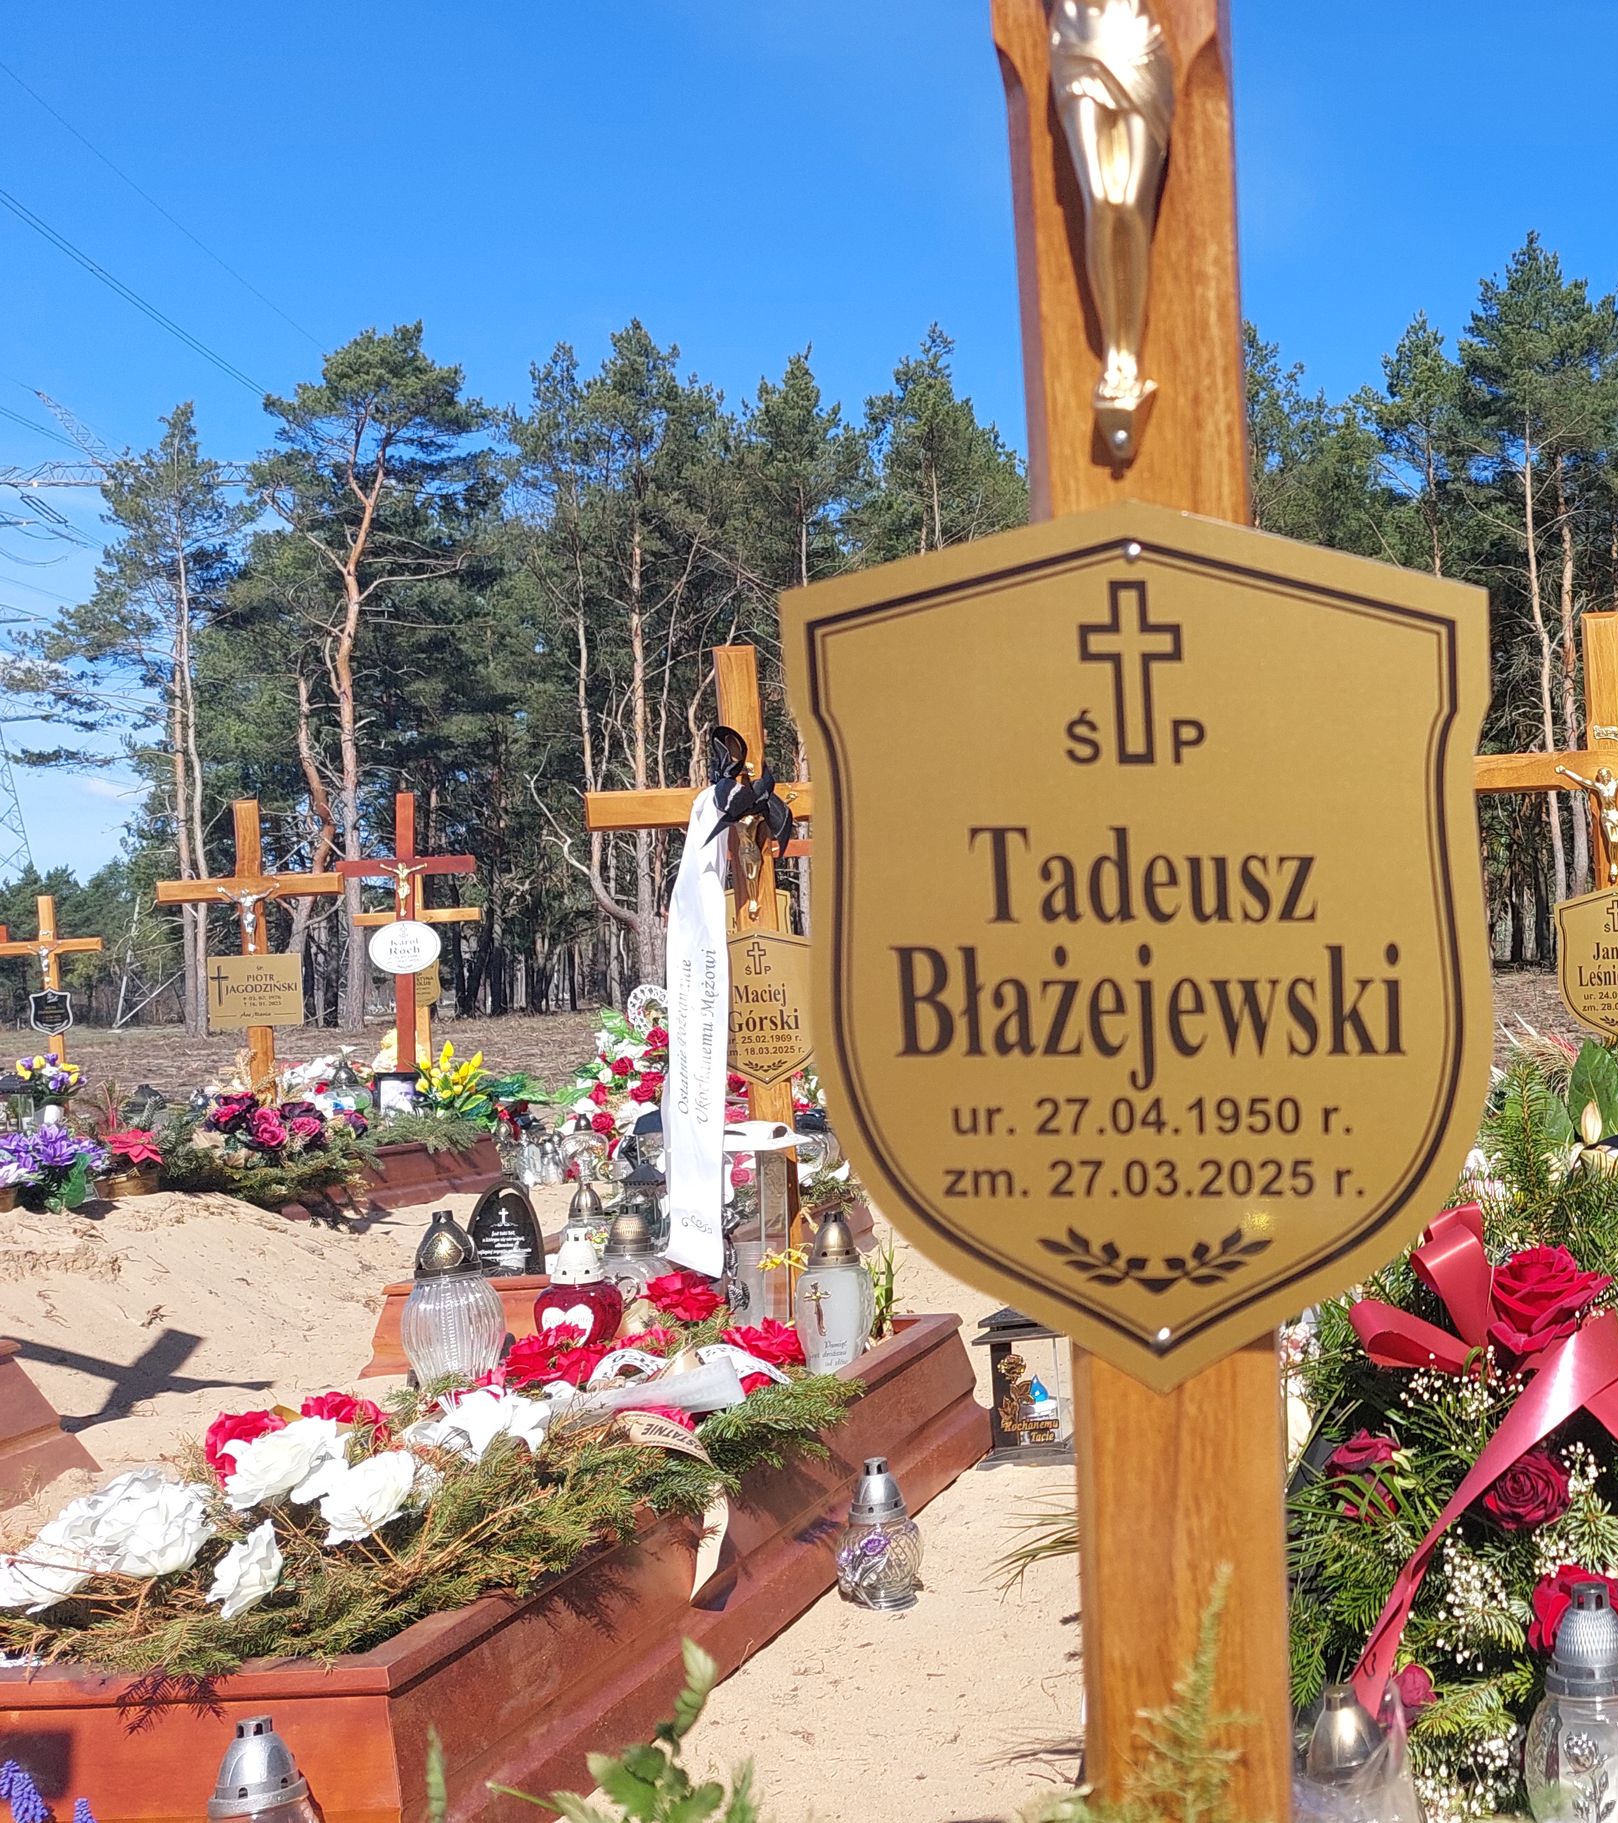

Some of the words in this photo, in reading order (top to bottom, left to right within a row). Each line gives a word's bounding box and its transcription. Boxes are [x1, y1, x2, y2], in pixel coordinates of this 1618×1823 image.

[1064, 709, 1102, 766] Ś
[1171, 718, 1207, 766] P
[968, 825, 1318, 925] Tadeusz
[225, 980, 298, 995] JAGODZIŃSKI
[246, 973, 275, 982] PIOTR
[700, 948, 719, 1018] Mężowi
[733, 982, 788, 1007] Maciej
[1581, 1004, 1599, 1012] zm.
[1583, 993, 1597, 1001] ur.
[728, 1008, 800, 1034] Górski
[890, 943, 1407, 1091] Błażejewski
[741, 1034, 793, 1045] 25.02.1969
[744, 1045, 796, 1056] 18.03.2025
[677, 1049, 690, 1116] Ostatnie
[952, 1106, 1015, 1136] ur.
[1035, 1096, 1302, 1136] 27.04.1950
[1322, 1106, 1353, 1136] r.
[943, 1168, 1030, 1199] zm.
[1050, 1159, 1315, 1199] 27.03.2025
[1334, 1168, 1365, 1198] r.
[640, 1422, 703, 1452] OSTATNIE
